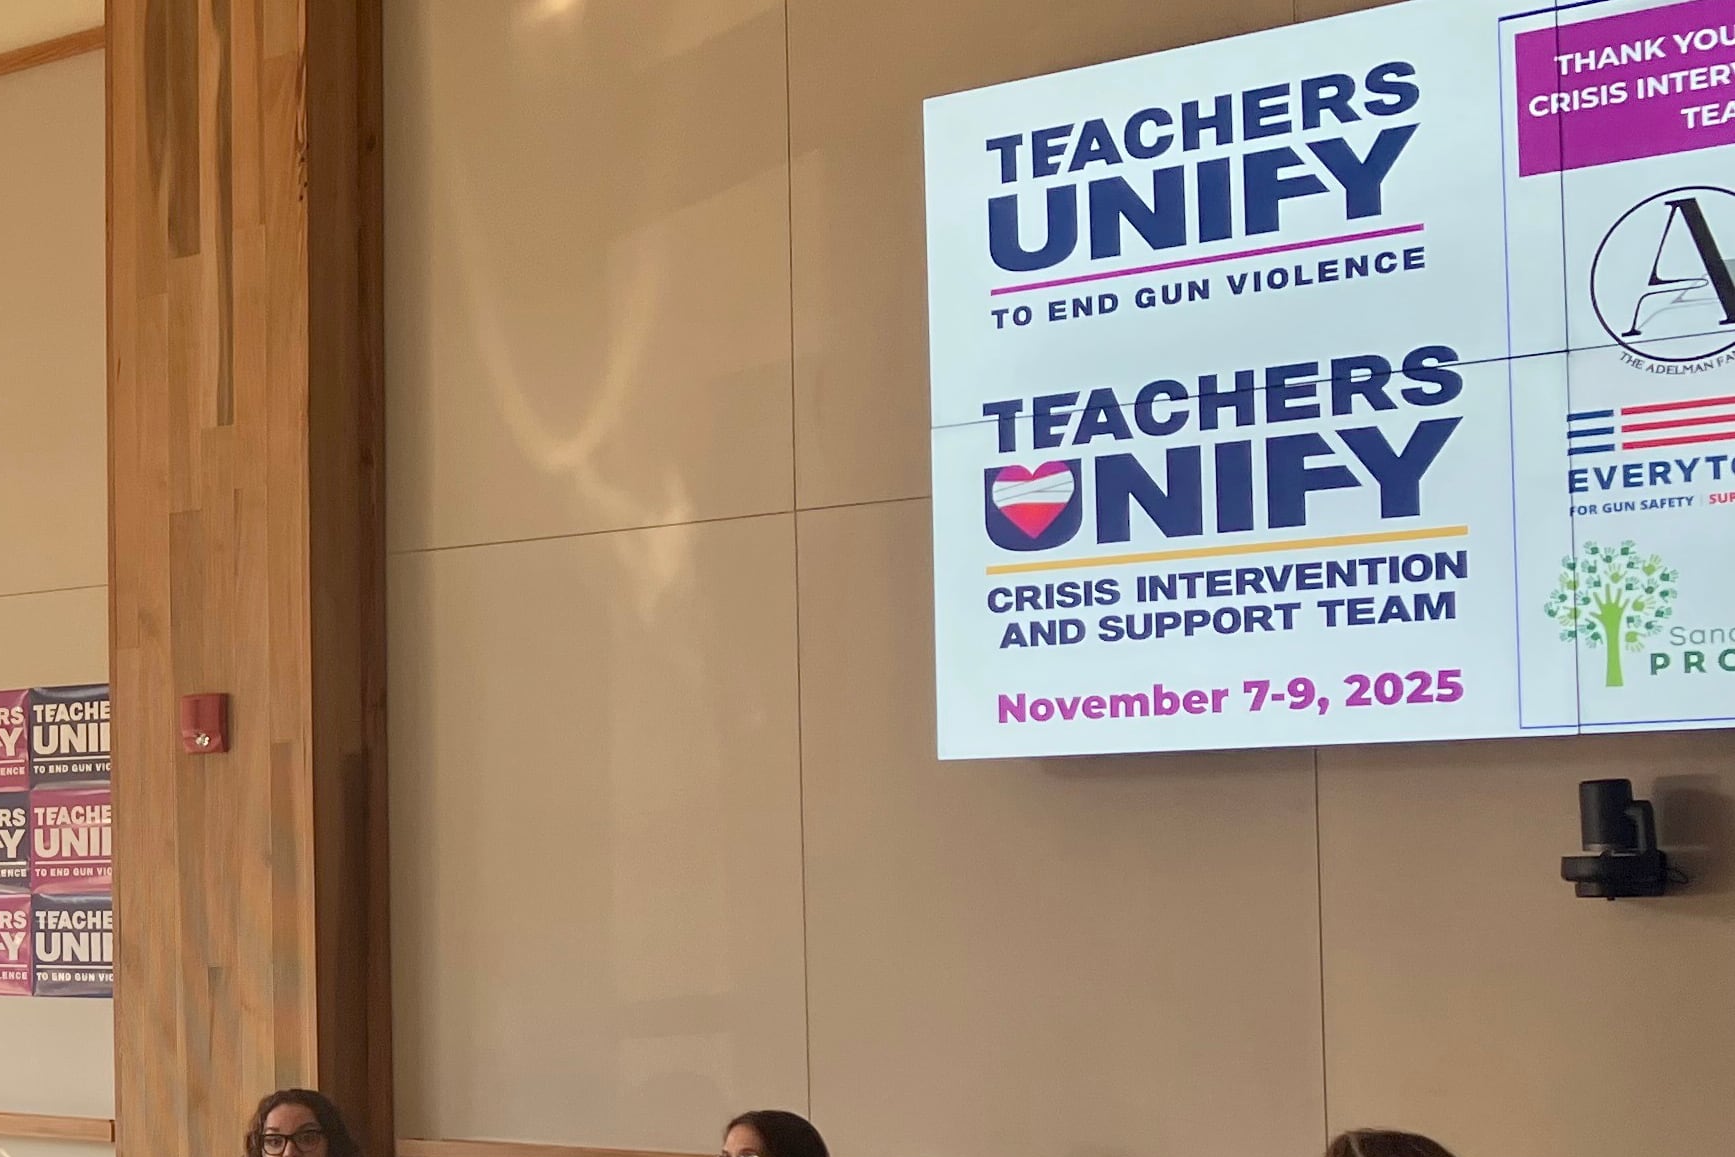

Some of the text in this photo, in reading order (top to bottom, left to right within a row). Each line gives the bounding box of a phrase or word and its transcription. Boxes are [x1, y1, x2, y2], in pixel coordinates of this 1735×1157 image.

[1554, 36, 1666, 76] THANK
[1528, 62, 1735, 117] CRISIS INTER
[985, 61, 1421, 184] TEACHERS
[1680, 100, 1735, 130] TEA
[987, 123, 1421, 273] UNIFY
[991, 246, 1425, 329] TO END GUN VIOLENCE
[1620, 351, 1735, 375] THE ADELMAN FA
[982, 345, 1463, 453] TEACHERS
[984, 416, 1463, 552] UNIFY
[1568, 454, 1735, 494] EVERYT
[1569, 491, 1735, 517] FOR GUN SAFETY SUP
[986, 550, 1468, 615] CRISIS INTERVENTION
[999, 591, 1457, 650] AND SUPPORT TEAM
[1650, 648, 1735, 676] PRO
[33, 700, 111, 723] TEACHE
[997, 669, 1465, 724] November 7-9, 2025
[33, 765, 45, 774] TO
[34, 805, 111, 826] TEACHE
[35, 868, 47, 877] TO
[97, 866, 112, 876] VIO
[35, 910, 113, 930] TEACHE
[36, 972, 48, 981] TO
